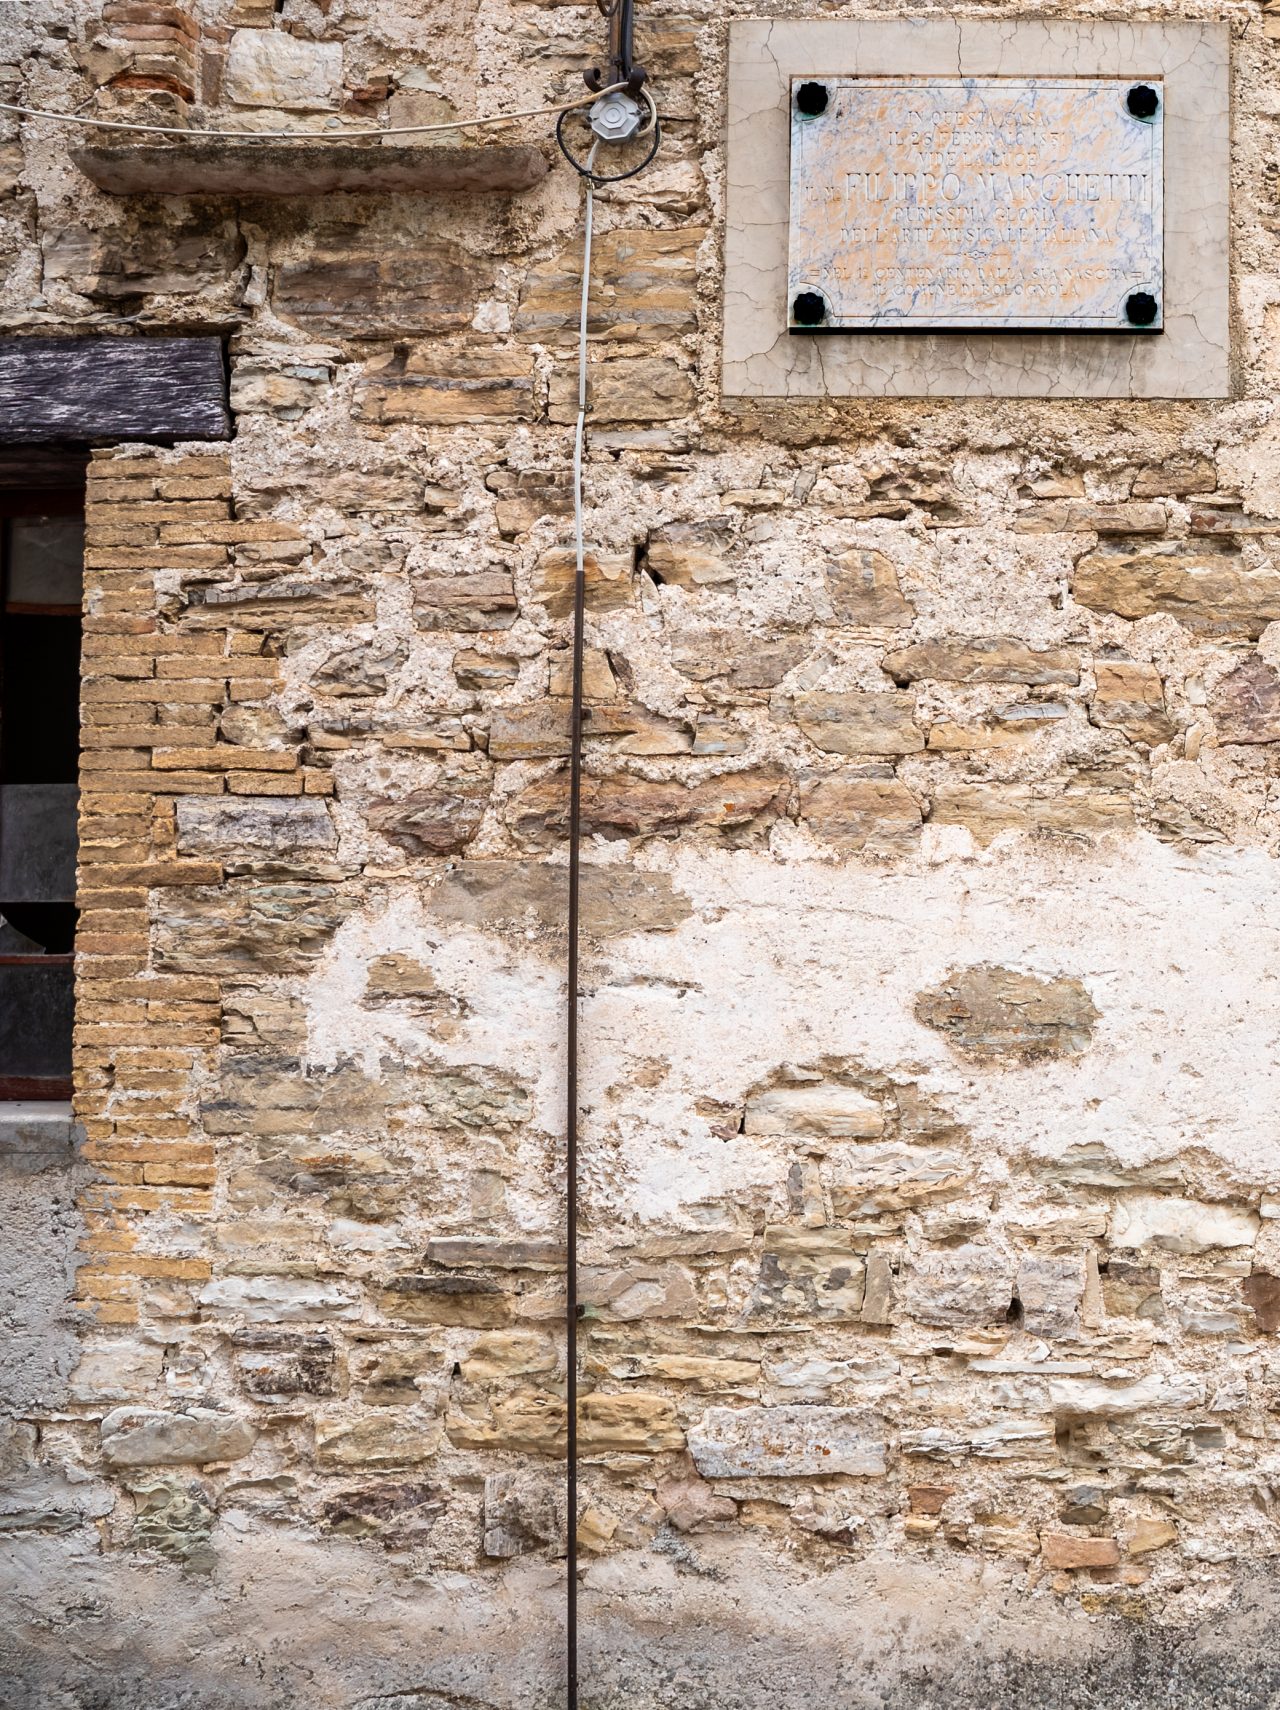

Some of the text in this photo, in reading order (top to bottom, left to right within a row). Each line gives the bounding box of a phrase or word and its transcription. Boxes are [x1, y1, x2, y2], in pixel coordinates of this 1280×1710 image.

[907, 110, 1050, 127] IN QUESTA CASA
[888, 131, 904, 145] IL
[911, 131, 932, 145] 26
[938, 131, 1025, 146] FEBBRAIO
[918, 151, 1040, 167] VIDE LA LUCE
[805, 186, 819, 201] IL
[845, 173, 962, 201] FILIPPO
[976, 173, 1148, 201] MARCHETTI
[894, 206, 1058, 222] PURISSIMA GLORIA
[942, 227, 1028, 243] MUSICALE
[1034, 227, 1113, 243] ITALIANA
[823, 267, 851, 280] NEL
[875, 267, 971, 280] CENTENARIO
[978, 267, 1025, 280] DALLA
[1032, 267, 1058, 281] SUA
[1064, 267, 1128, 281] NASCITA
[873, 283, 1080, 297] IL COMUNE DI BOLOGNOLA
